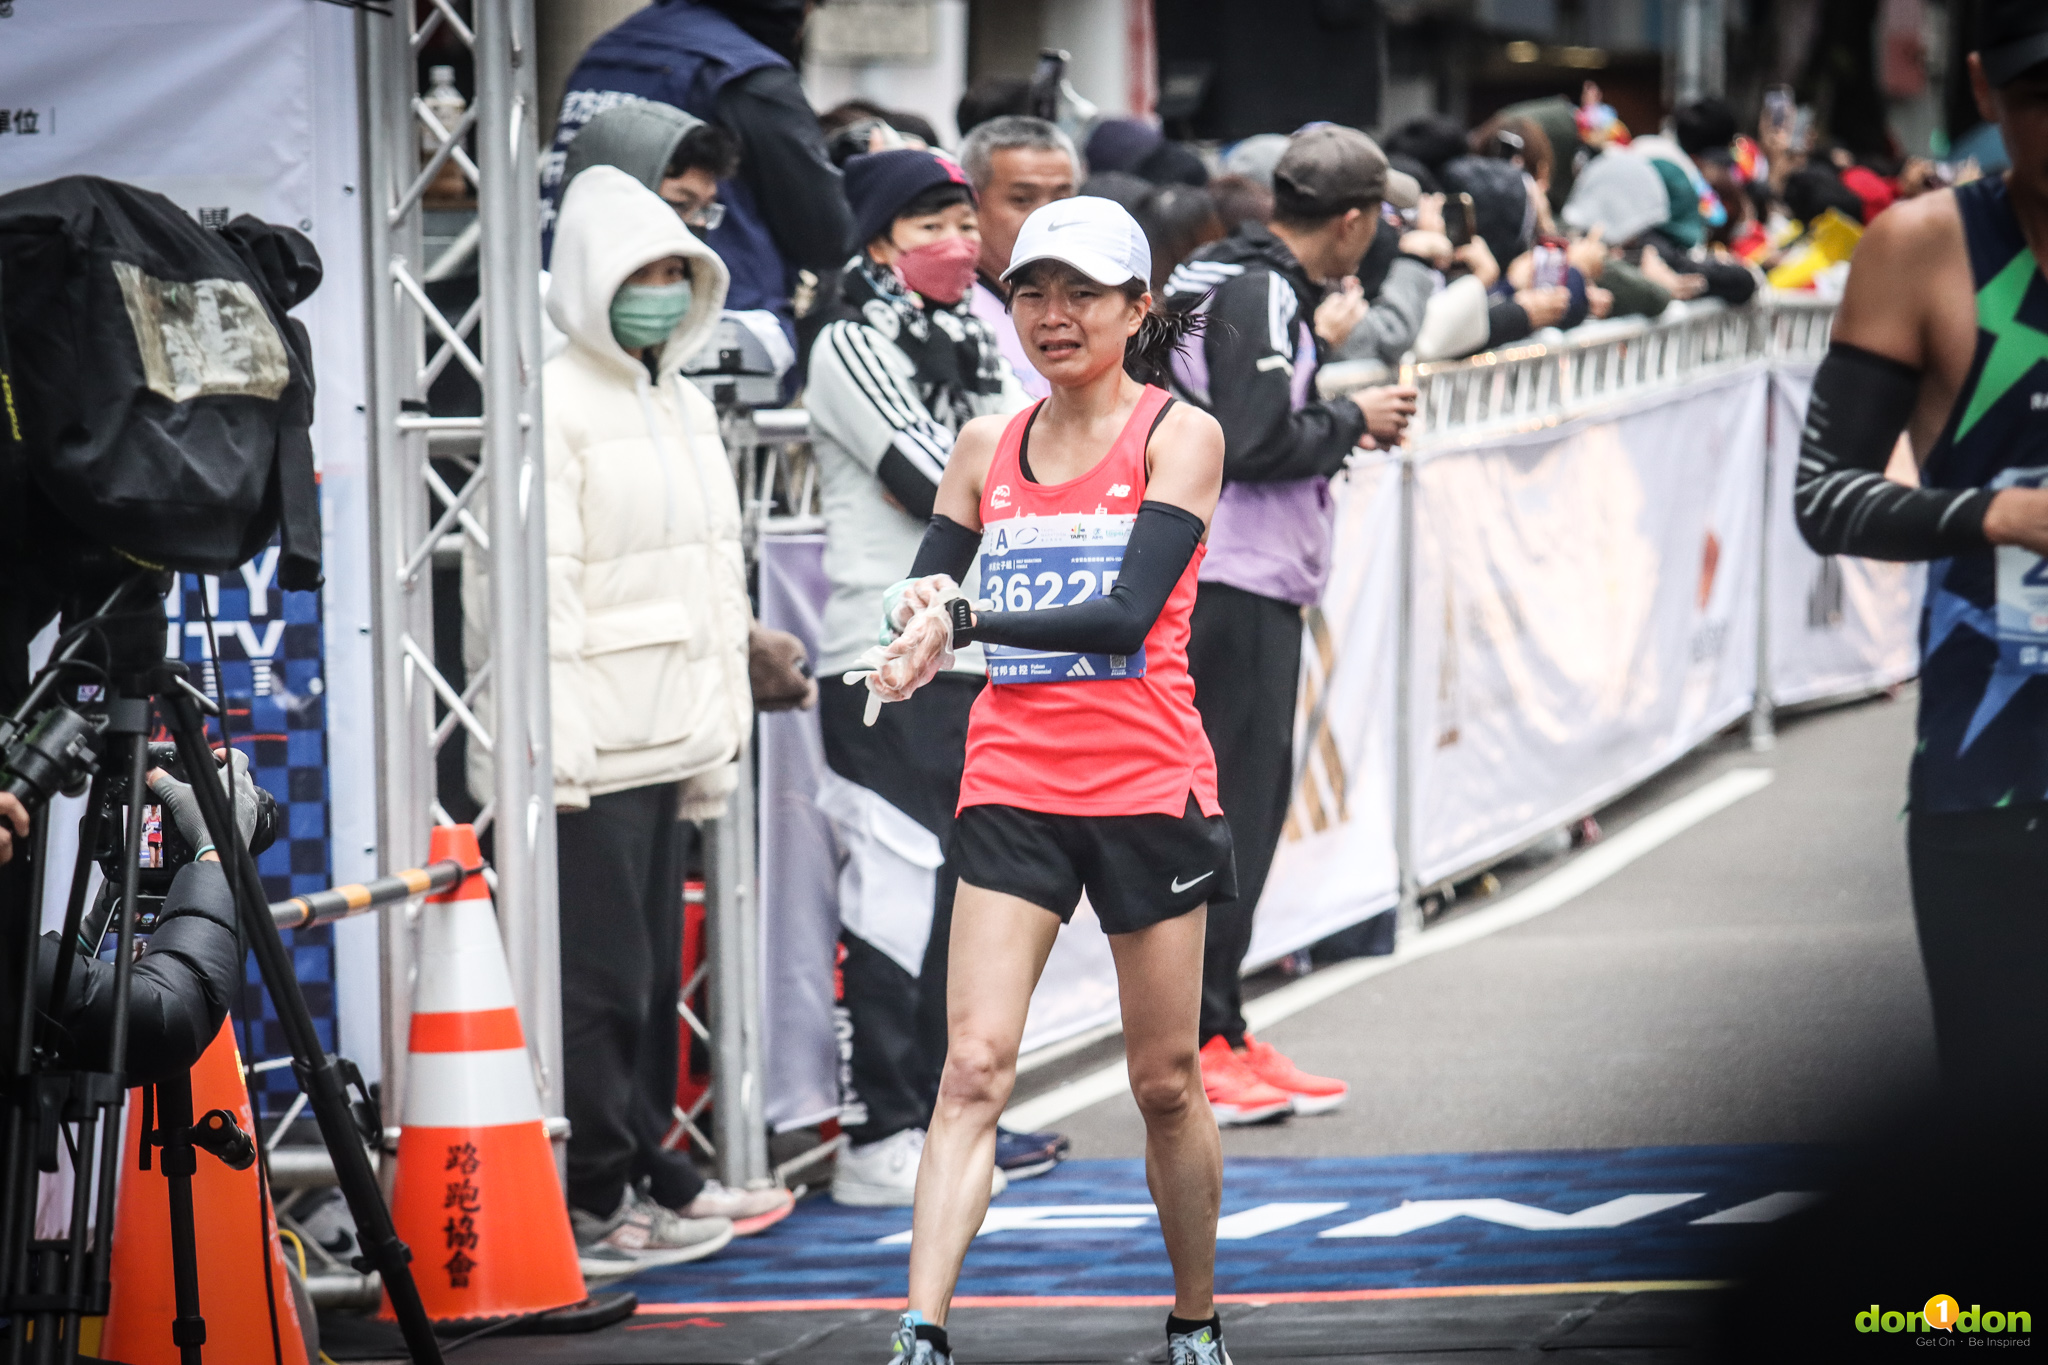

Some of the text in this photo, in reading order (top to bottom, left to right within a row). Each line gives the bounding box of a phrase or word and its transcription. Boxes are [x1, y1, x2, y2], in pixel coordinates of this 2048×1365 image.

[995, 528, 1009, 551] A
[443, 1141, 481, 1288] 路跑協會
